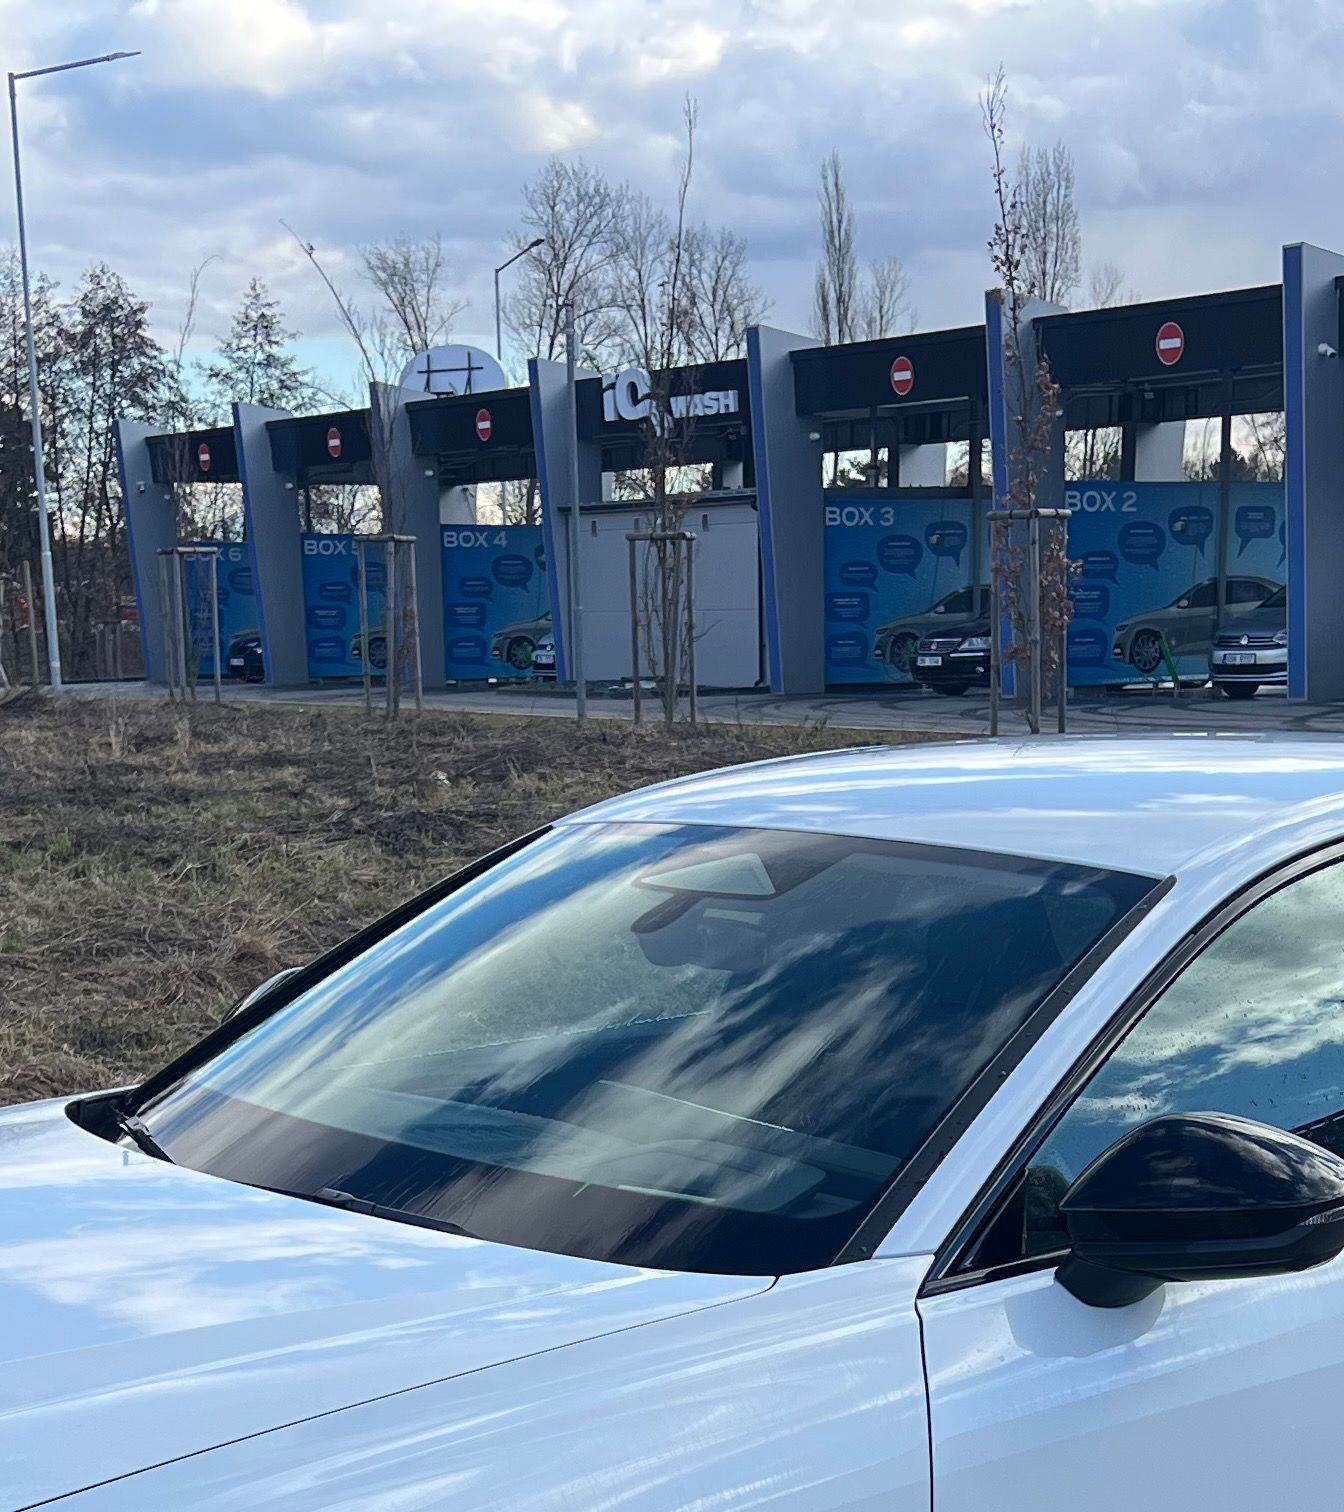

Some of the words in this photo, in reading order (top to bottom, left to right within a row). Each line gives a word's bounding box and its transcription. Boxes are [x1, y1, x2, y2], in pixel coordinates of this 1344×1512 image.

[670, 389, 739, 419] WASH
[1065, 491, 1117, 513] BOX
[1122, 491, 1137, 513] 2
[825, 506, 874, 526] BOX
[879, 506, 895, 526] 3
[303, 539, 347, 555] BOX
[443, 531, 489, 548] BOX
[493, 531, 508, 547] 4
[228, 547, 242, 561] 6
